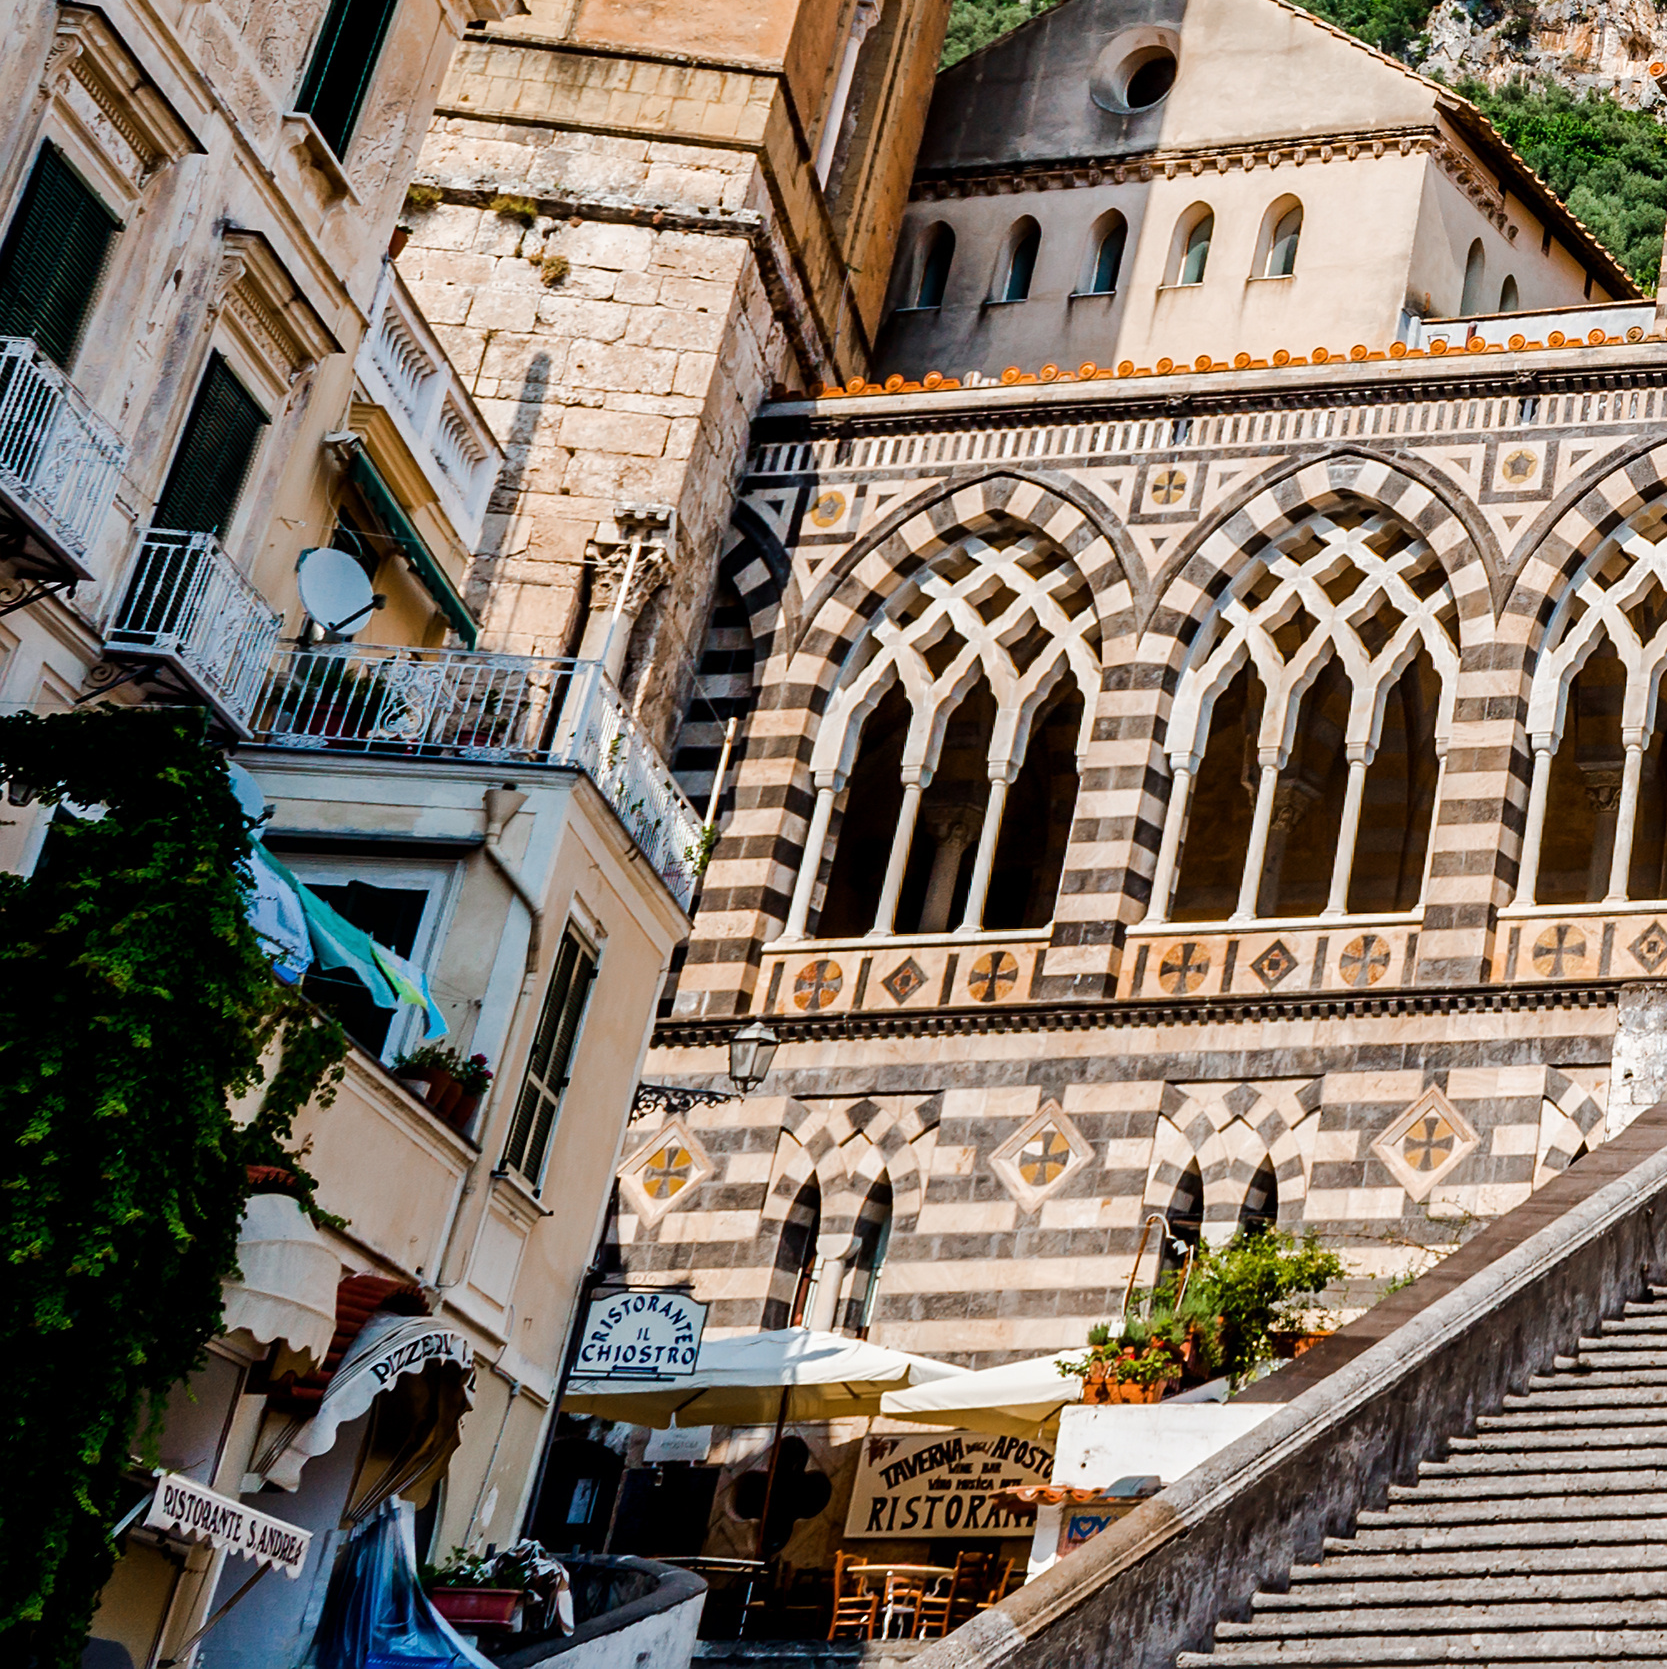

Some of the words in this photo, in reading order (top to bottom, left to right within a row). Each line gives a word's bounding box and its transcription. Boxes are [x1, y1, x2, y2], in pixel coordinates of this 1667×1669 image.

[591, 1295, 693, 1345] RISTORANTE
[636, 1327, 650, 1341] IL
[581, 1343, 696, 1365] CHIOSTRO
[879, 1437, 965, 1490] TAVERNA
[164, 1485, 243, 1543] RISTORANTE
